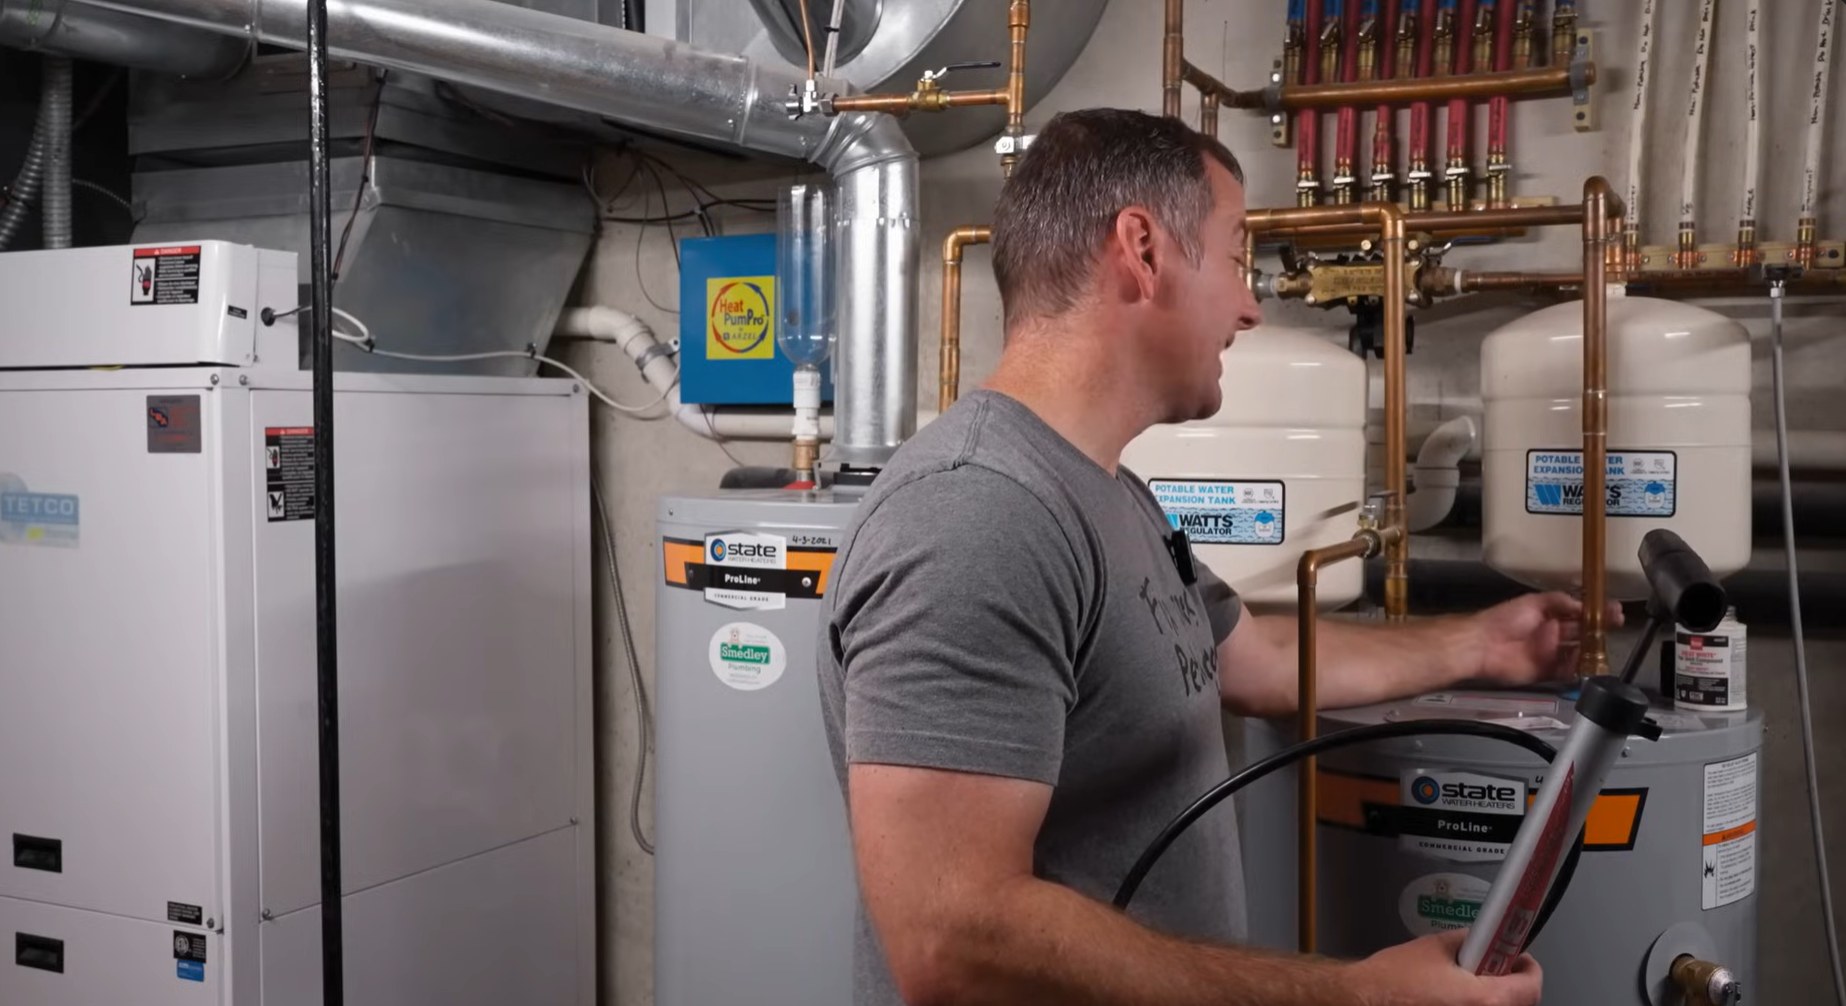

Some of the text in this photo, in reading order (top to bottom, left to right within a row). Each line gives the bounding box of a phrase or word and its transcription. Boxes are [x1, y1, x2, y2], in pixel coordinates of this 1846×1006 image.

[720, 299, 743, 312] Heat
[1536, 455, 1581, 464] POTABLE
[1534, 466, 1584, 474] EXPANSIO
[1155, 485, 1234, 494] POTABLE WATER
[4, 496, 74, 516] TETCO
[1208, 496, 1236, 504] TANK
[1180, 514, 1233, 528] WATTS
[792, 535, 832, 546] 4-3-2021
[728, 542, 776, 558] state
[725, 573, 759, 585] ProLine
[714, 593, 748, 601] COMMERCIAL
[721, 645, 767, 663] Smedley
[1442, 783, 1515, 801] state
[1442, 798, 1515, 809] WATER HEATERS
[1437, 820, 1488, 833] ProLine
[1419, 842, 1505, 854] COMMERCIAL GRADE
[1421, 899, 1480, 919] Smedle
